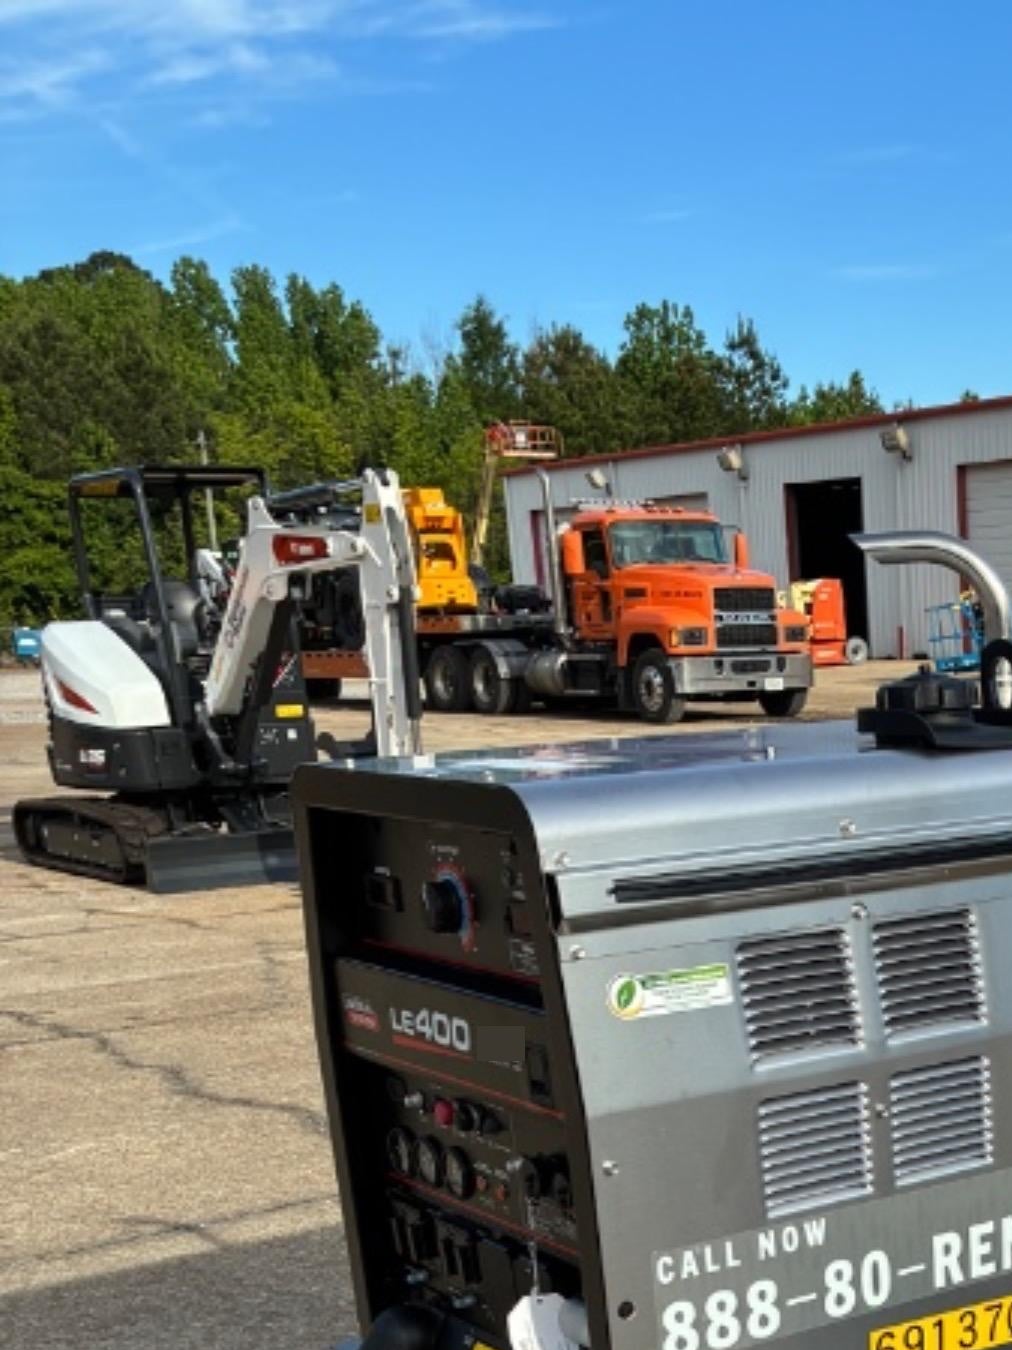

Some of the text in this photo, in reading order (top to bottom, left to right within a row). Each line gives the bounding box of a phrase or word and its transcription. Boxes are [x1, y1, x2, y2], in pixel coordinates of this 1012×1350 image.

[389, 1007, 471, 1052] LE400
[656, 1217, 827, 1285] CALL NOW
